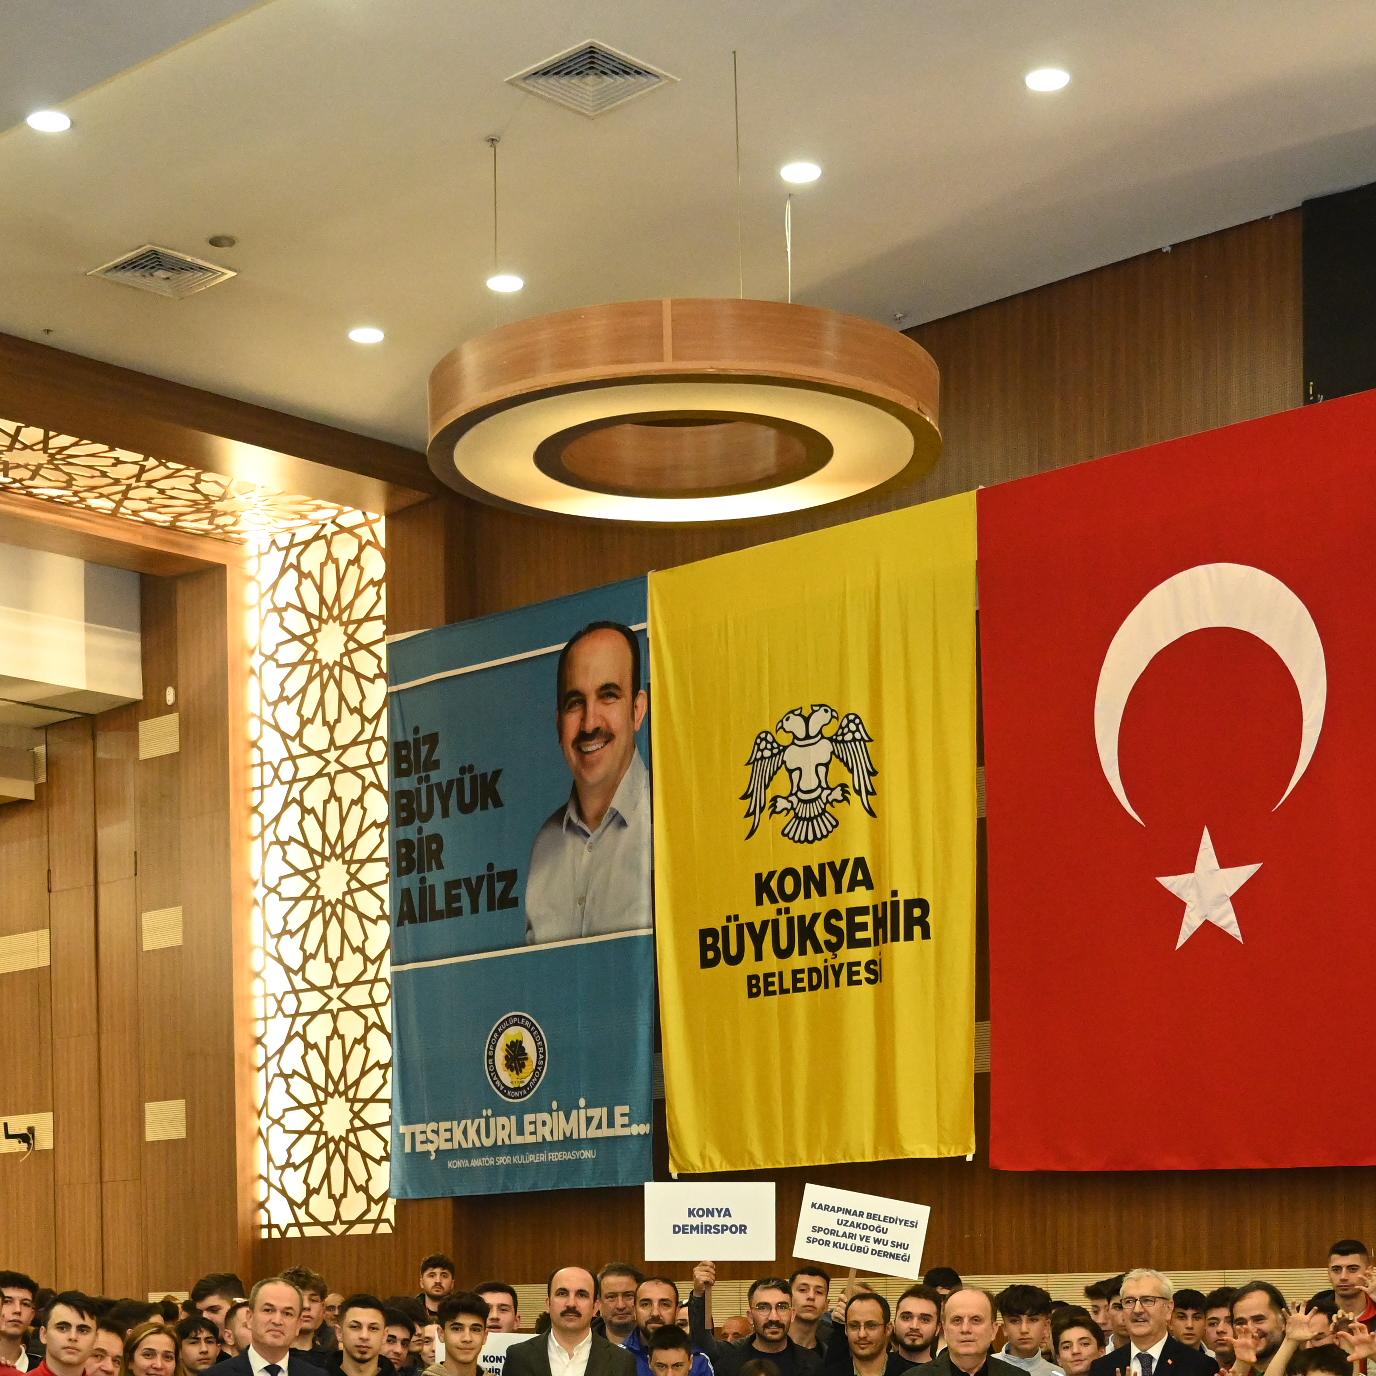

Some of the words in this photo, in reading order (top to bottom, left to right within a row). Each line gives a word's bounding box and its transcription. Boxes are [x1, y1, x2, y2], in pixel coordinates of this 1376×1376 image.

[393, 725, 441, 779] BİZ
[395, 764, 504, 828] BÜYÜK
[395, 825, 445, 878] BİR
[397, 862, 519, 927] AİLEYİZ
[754, 856, 874, 907] KONYA
[698, 889, 932, 970] BÜYÜKŞEHİR
[746, 952, 882, 999] BELEDİYESİ
[447, 1159, 470, 1169] KONYA
[496, 1155, 512, 1165] SPOR
[548, 1149, 597, 1161] FEDERASYONU
[672, 1221, 747, 1235] DEMİRSPOR
[687, 1207, 732, 1218] KONYA
[810, 1201, 864, 1218] KARAPINAR
[865, 1211, 919, 1229] BELEDİYESİ
[836, 1218, 889, 1235] UZAKDOĞU
[806, 1236, 831, 1248] SPOR
[832, 1240, 869, 1255] KULÜBÜ
[870, 1248, 911, 1263] DERNEĞİ
[811, 1225, 857, 1241] SPORLARI
[859, 1234, 871, 1243] VE
[873, 1236, 889, 1247] WU
[890, 1240, 909, 1251] SHU
